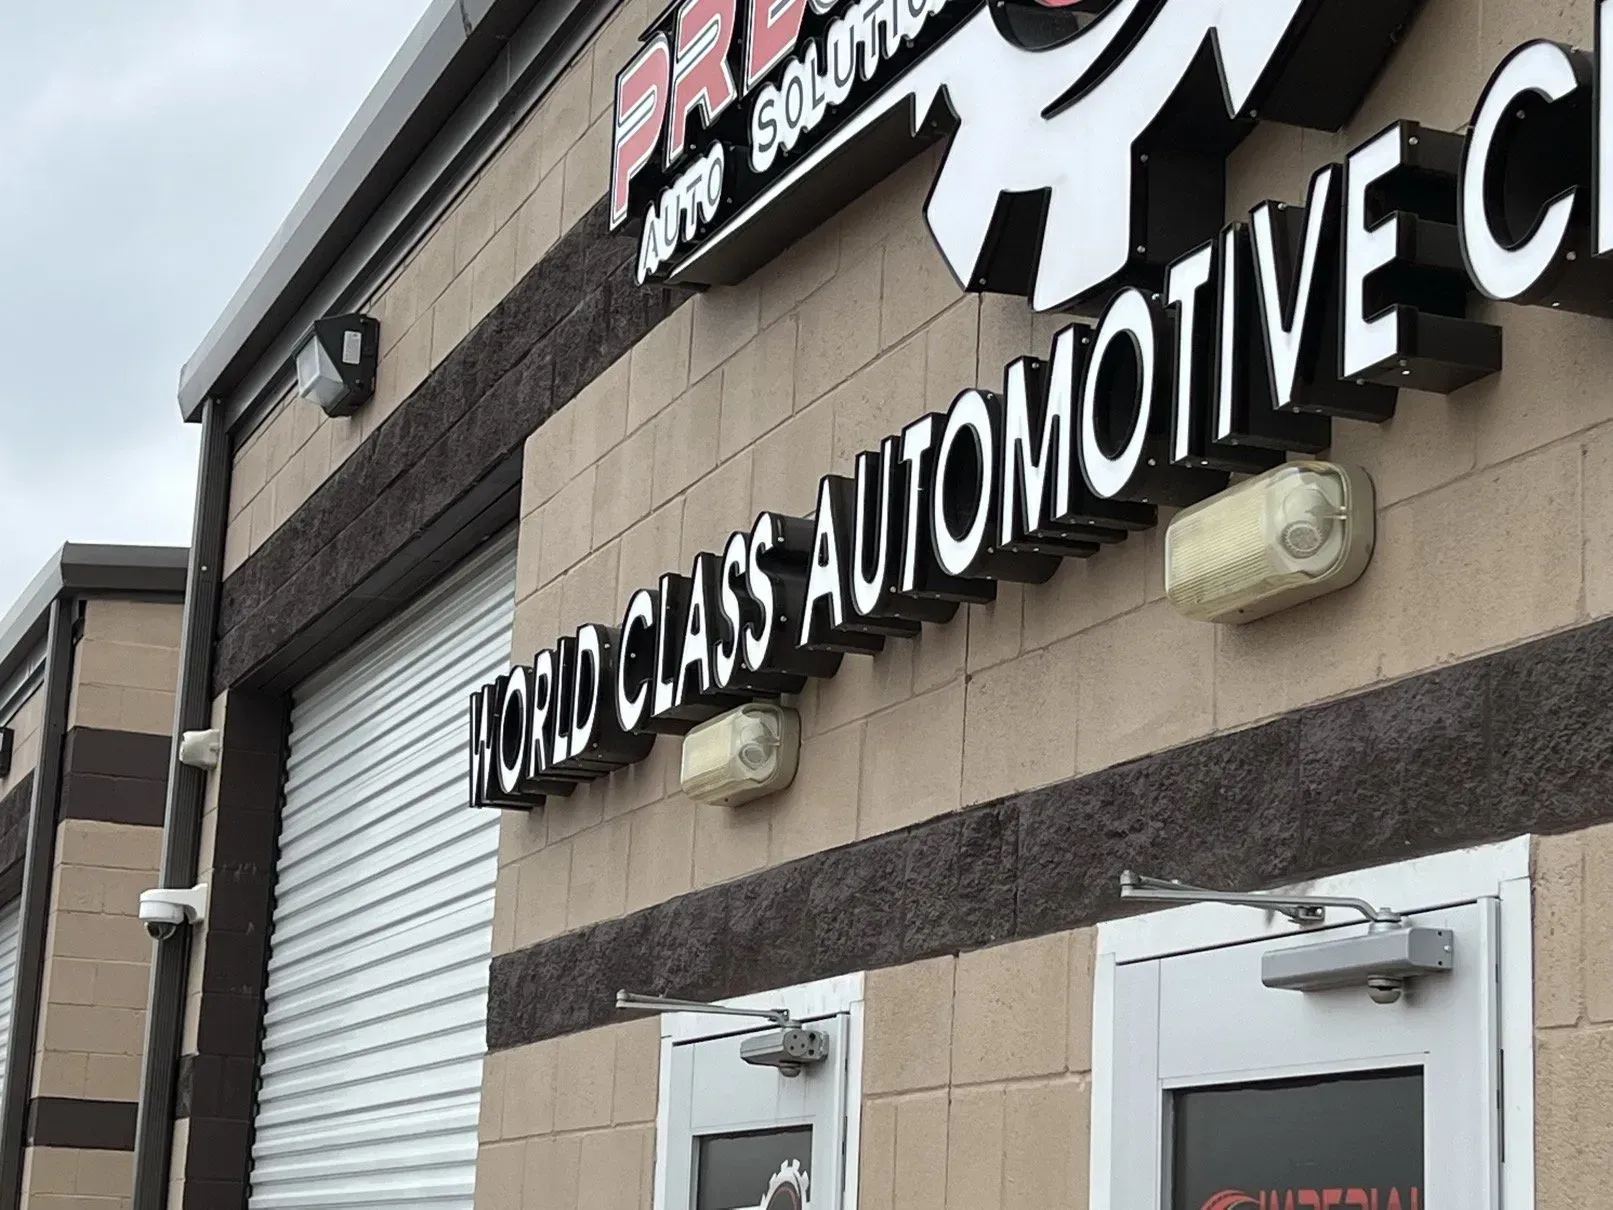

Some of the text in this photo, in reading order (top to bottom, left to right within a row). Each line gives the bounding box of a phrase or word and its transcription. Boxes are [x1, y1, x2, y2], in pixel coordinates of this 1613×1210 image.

[469, 0, 1613, 808] WORLD CLASS AUTOMOTIVE C
[636, 140, 724, 285] AUTO
